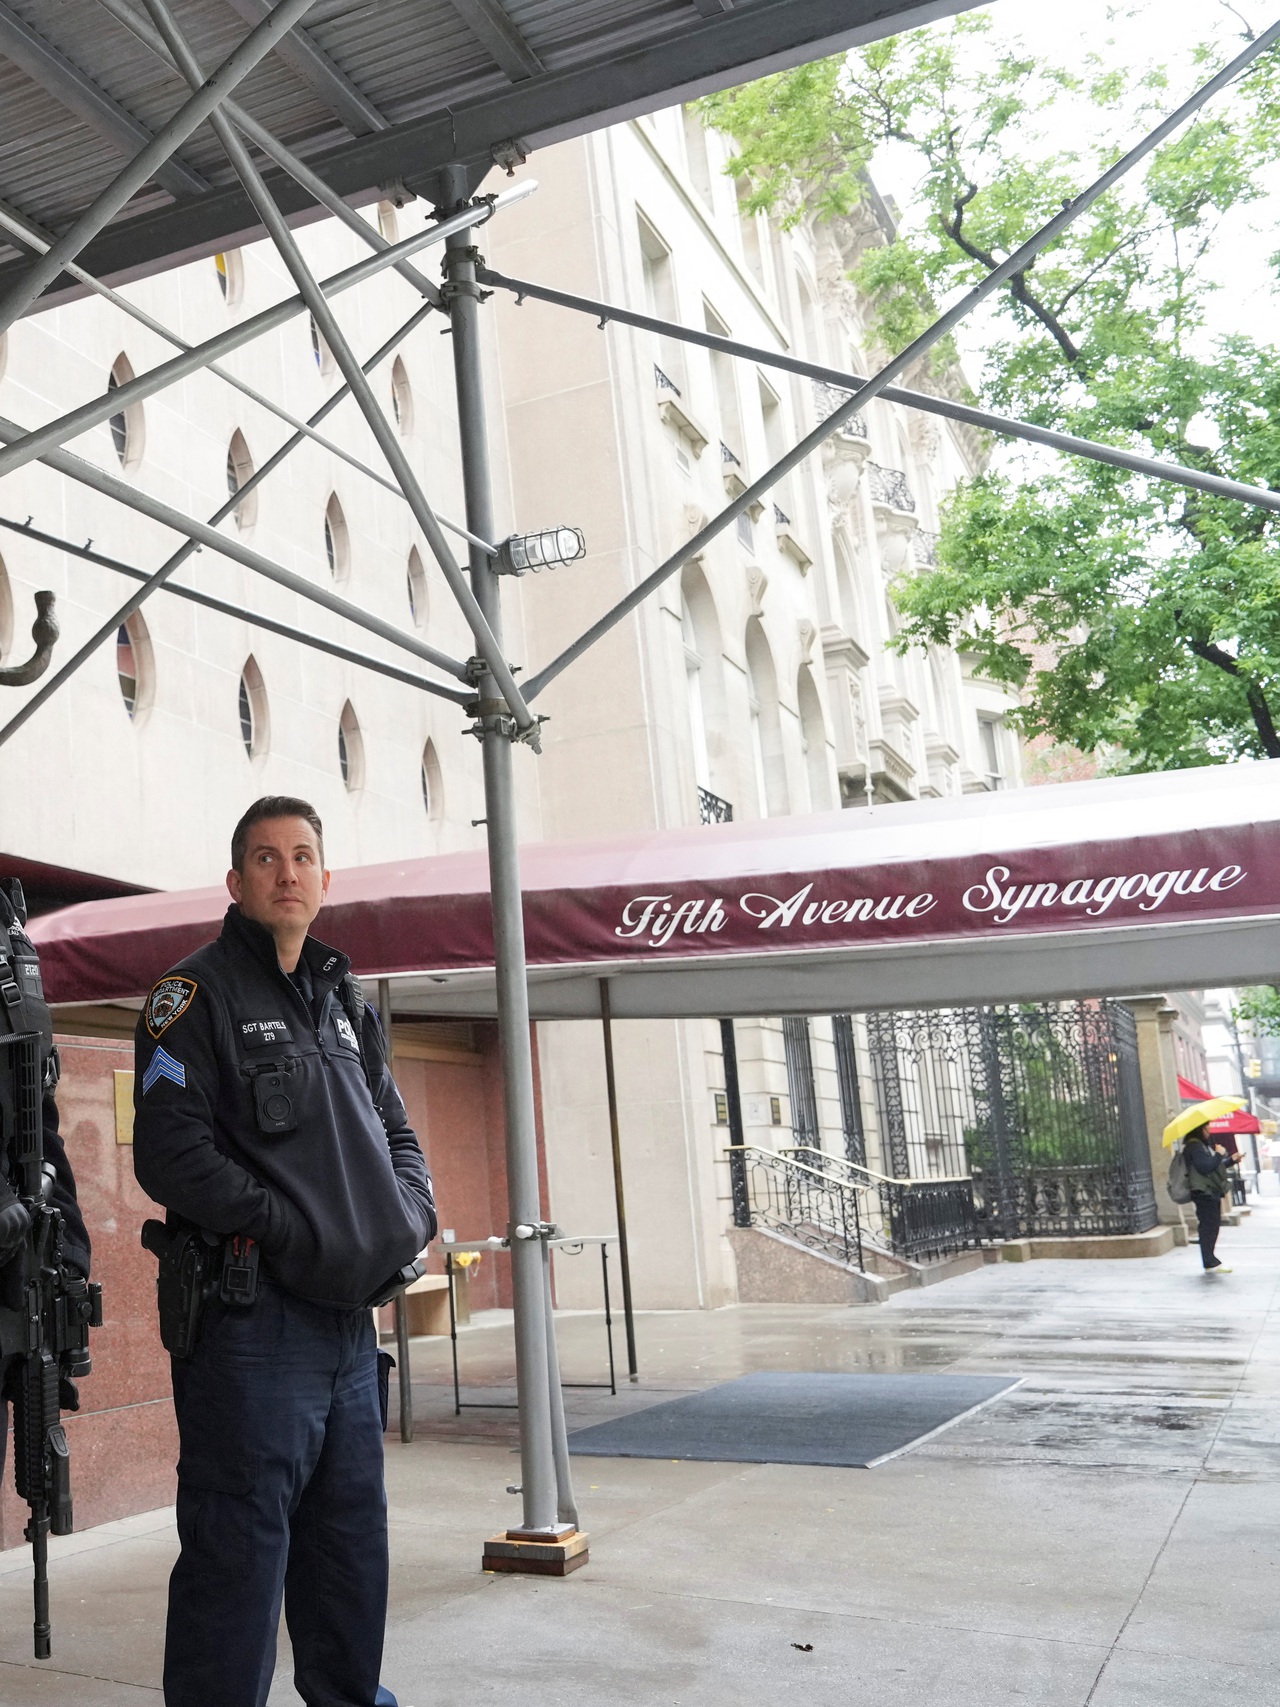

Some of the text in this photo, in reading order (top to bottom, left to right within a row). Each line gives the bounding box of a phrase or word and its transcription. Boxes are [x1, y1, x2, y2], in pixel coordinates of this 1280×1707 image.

[615, 865, 1247, 947] Fifth Avenue Synagogue
[322, 956, 337, 972] CTB
[172, 999, 188, 1016] YORK
[242, 1021, 287, 1034] SGT BARTELS
[263, 1031, 276, 1041] 279
